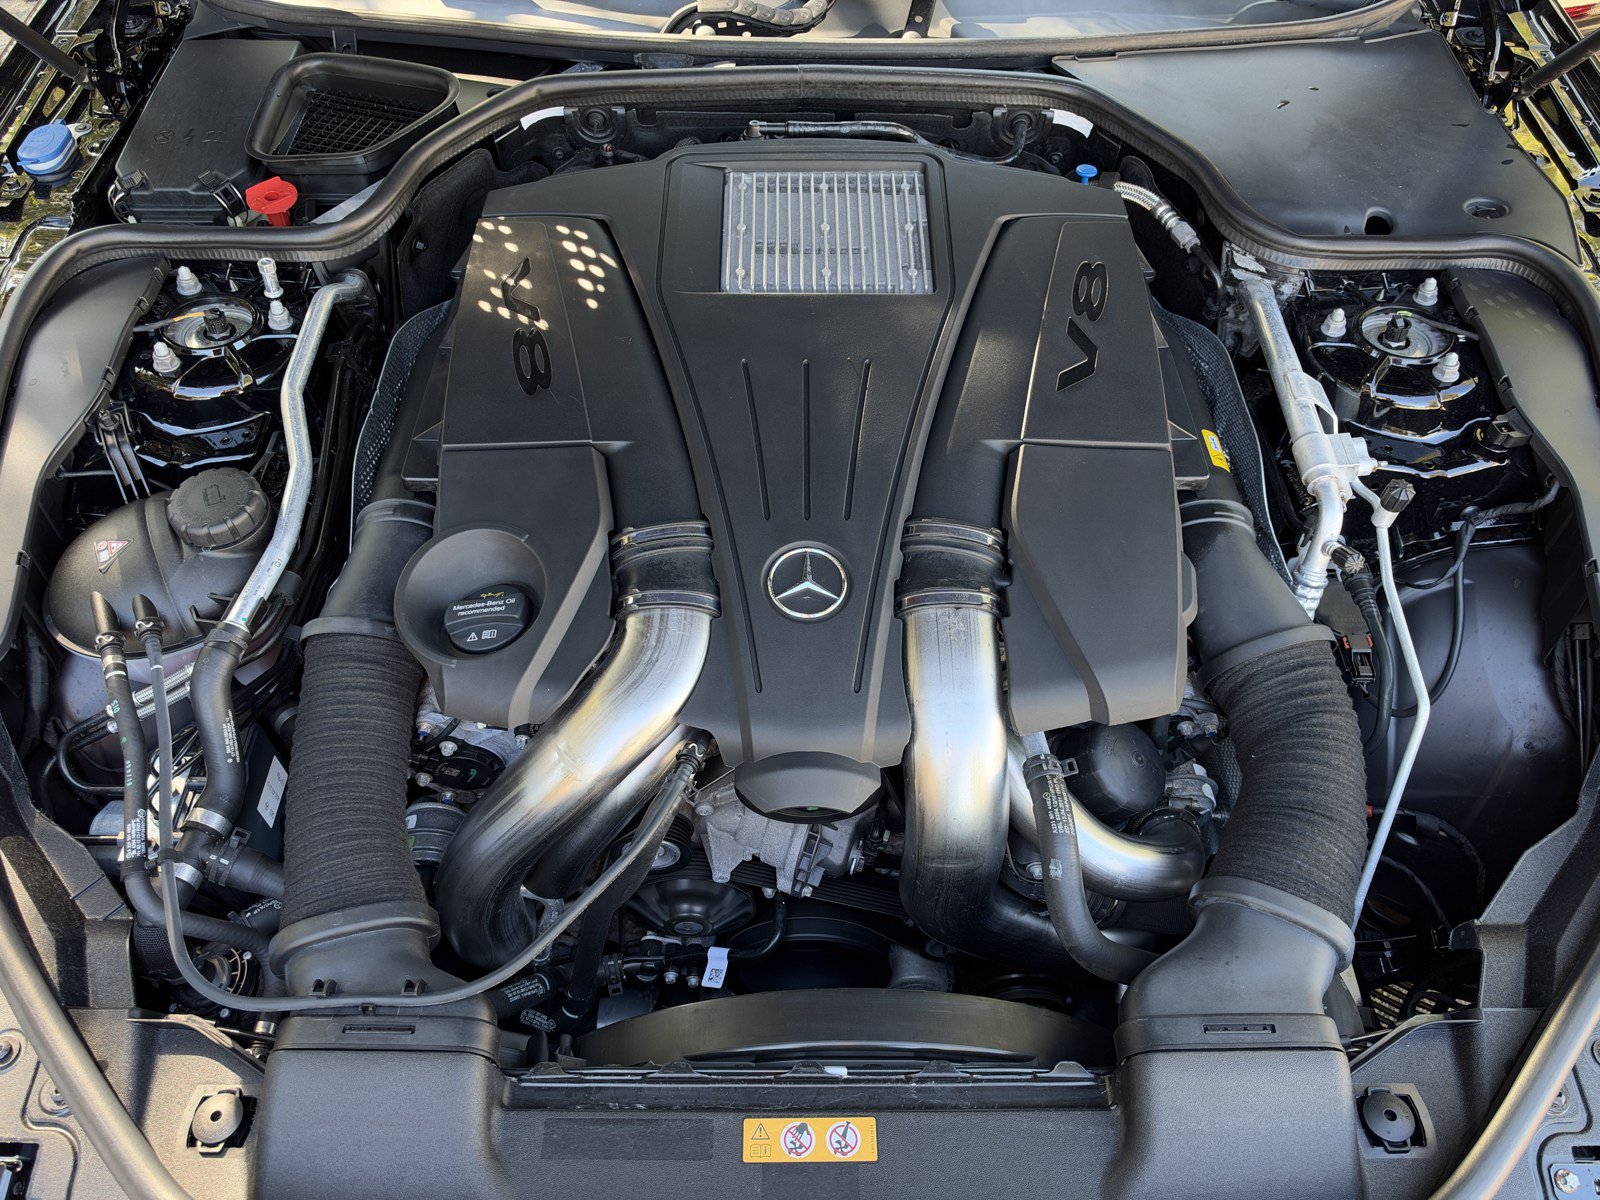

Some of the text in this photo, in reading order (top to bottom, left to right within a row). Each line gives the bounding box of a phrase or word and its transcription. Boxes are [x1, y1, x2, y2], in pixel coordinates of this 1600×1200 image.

[501, 255, 552, 396] V8
[1056, 260, 1109, 392] V8
[452, 600, 504, 611] Mercedes-Benz
[458, 606, 506, 616] recommended
